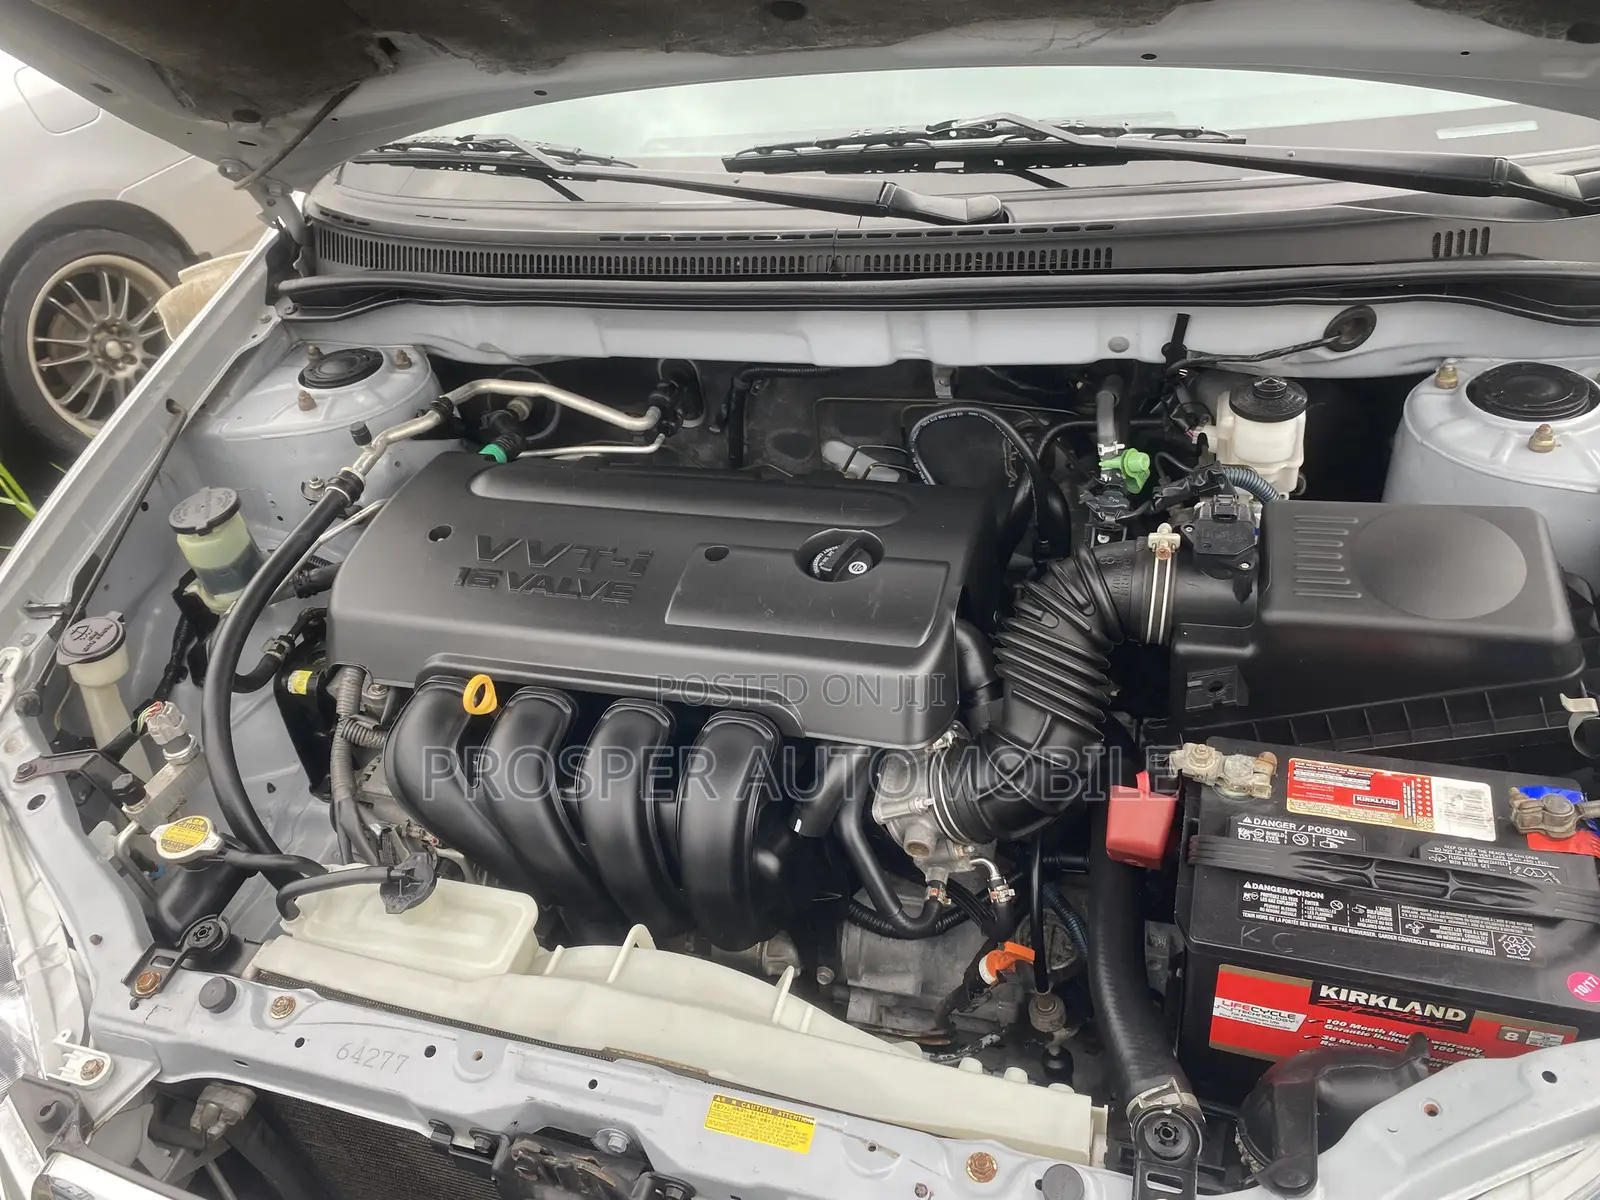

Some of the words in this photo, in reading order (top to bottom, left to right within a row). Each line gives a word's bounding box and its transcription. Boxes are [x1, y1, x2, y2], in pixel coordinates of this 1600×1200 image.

[476, 534, 654, 578] VVT-i
[506, 570, 637, 604] VALVE
[1356, 796, 1397, 806] KIRKLAND
[1253, 818, 1296, 830] DANGER
[1308, 825, 1348, 837] POISON
[1252, 883, 1324, 900] DANGER/POISON
[1573, 976, 1599, 997] 10/17
[1222, 1000, 1296, 1020] LIFECYCLE
[1319, 984, 1467, 1022] KIRKLAND
[1324, 1024, 1372, 1036] Garantie
[1326, 1018, 1348, 1027] 100
[1349, 1022, 1386, 1035] Month
[1431, 1039, 1484, 1053] warranty
[1503, 1031, 1520, 1042] 8
[336, 1041, 410, 1074] 64277
[741, 1102, 772, 1114] CAUTION
